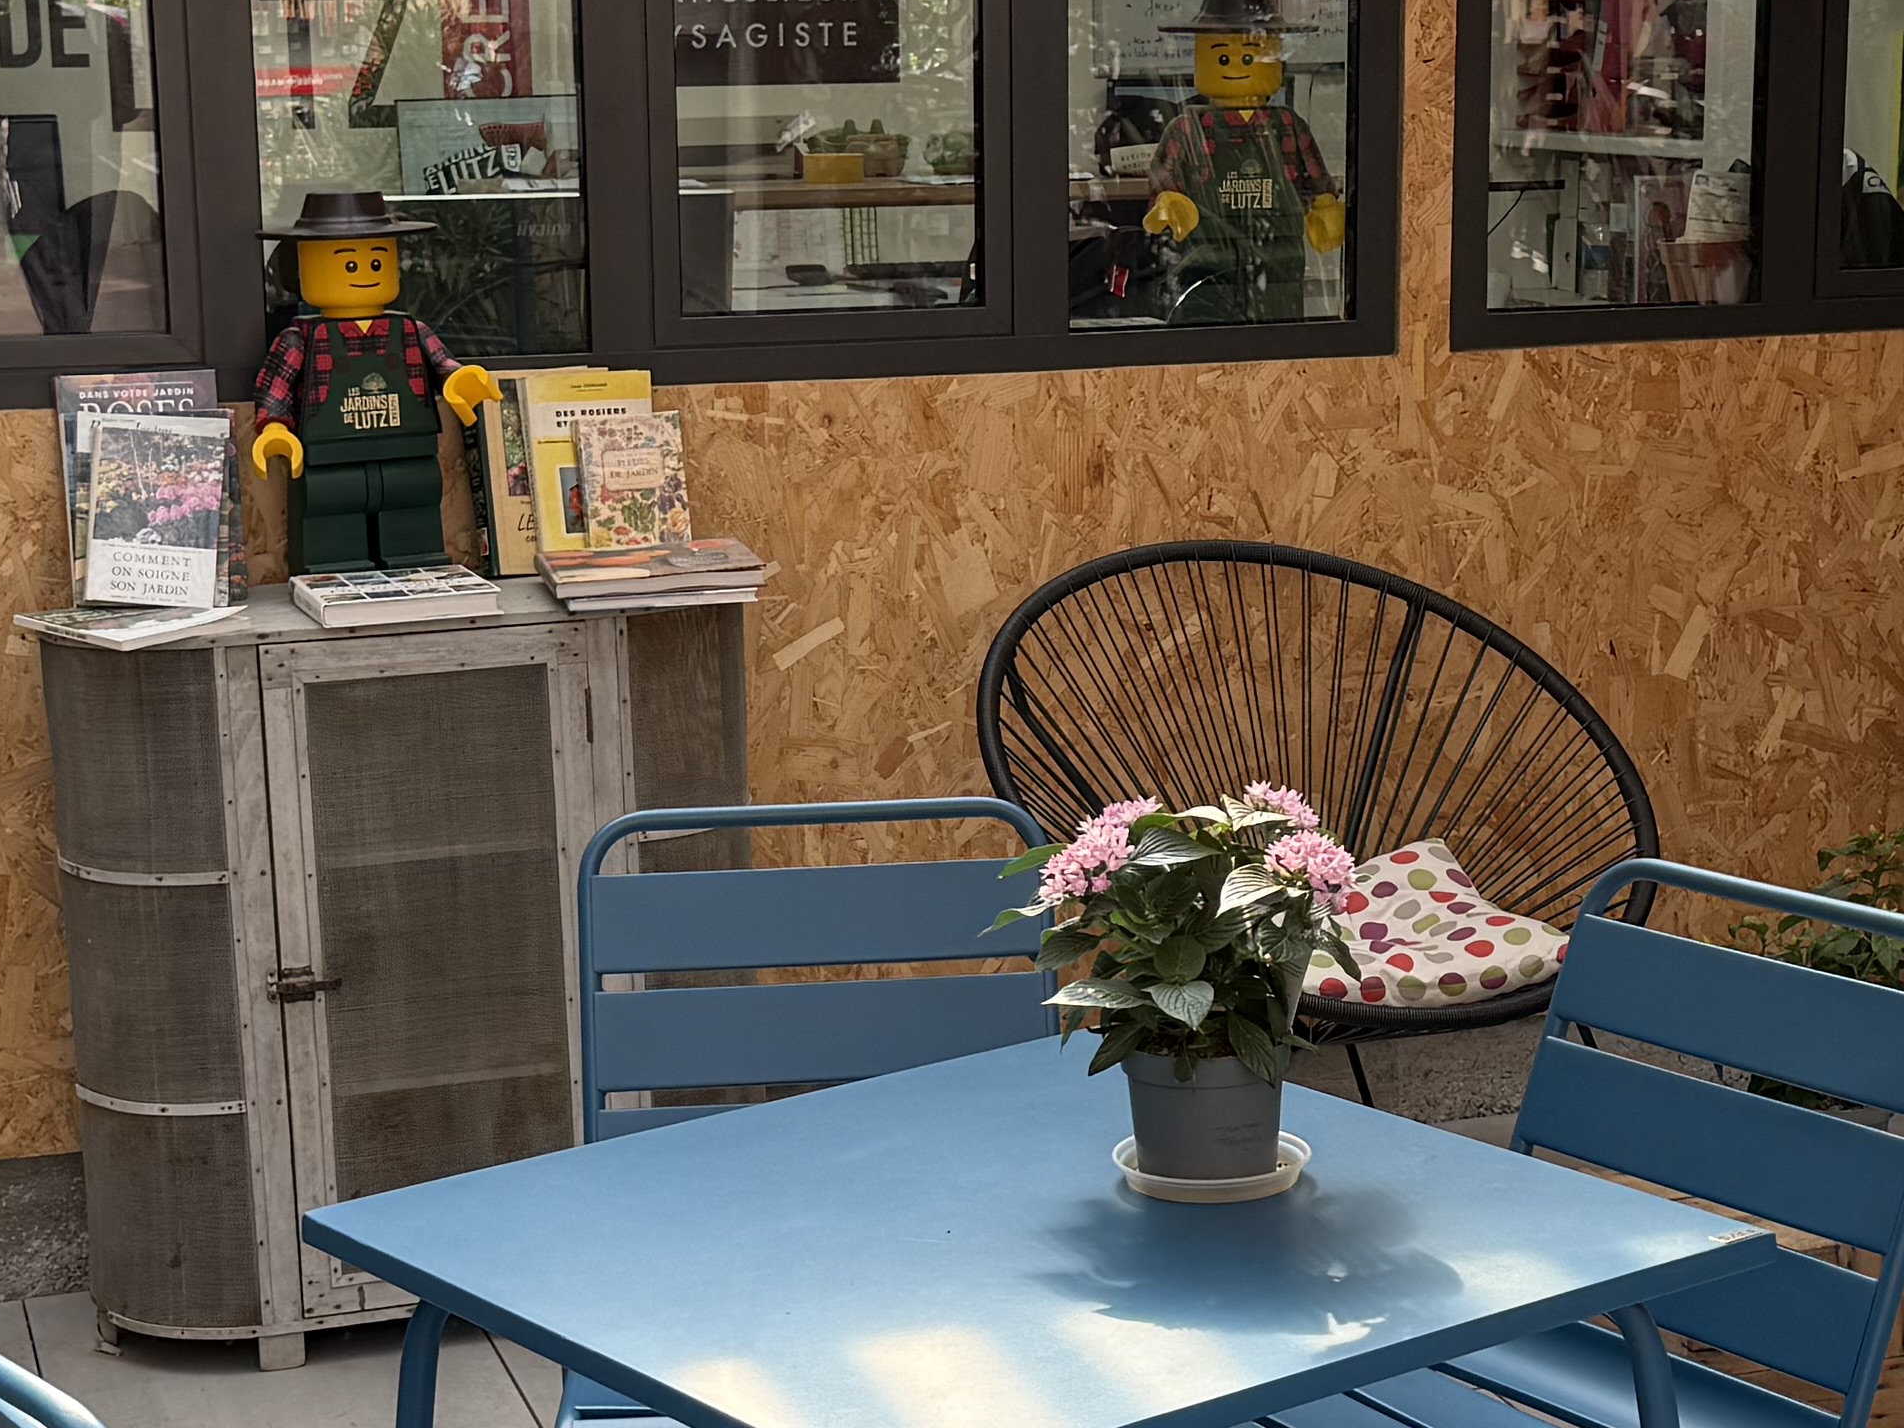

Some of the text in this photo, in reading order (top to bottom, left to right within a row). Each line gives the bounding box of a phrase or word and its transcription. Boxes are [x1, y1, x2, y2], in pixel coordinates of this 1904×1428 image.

[673, 22, 859, 49] SAGISTE
[1231, 192, 1262, 209] LUTZ
[79, 387, 194, 399] DANS VOTRE JARDIN
[339, 394, 388, 413] JARDINS
[354, 409, 389, 430] LUTZ
[555, 407, 627, 418] DES ROSIERS
[113, 551, 191, 567] COMMENT
[111, 565, 191, 582] ON SOIGNE
[110, 579, 189, 596] SON JARDIN
